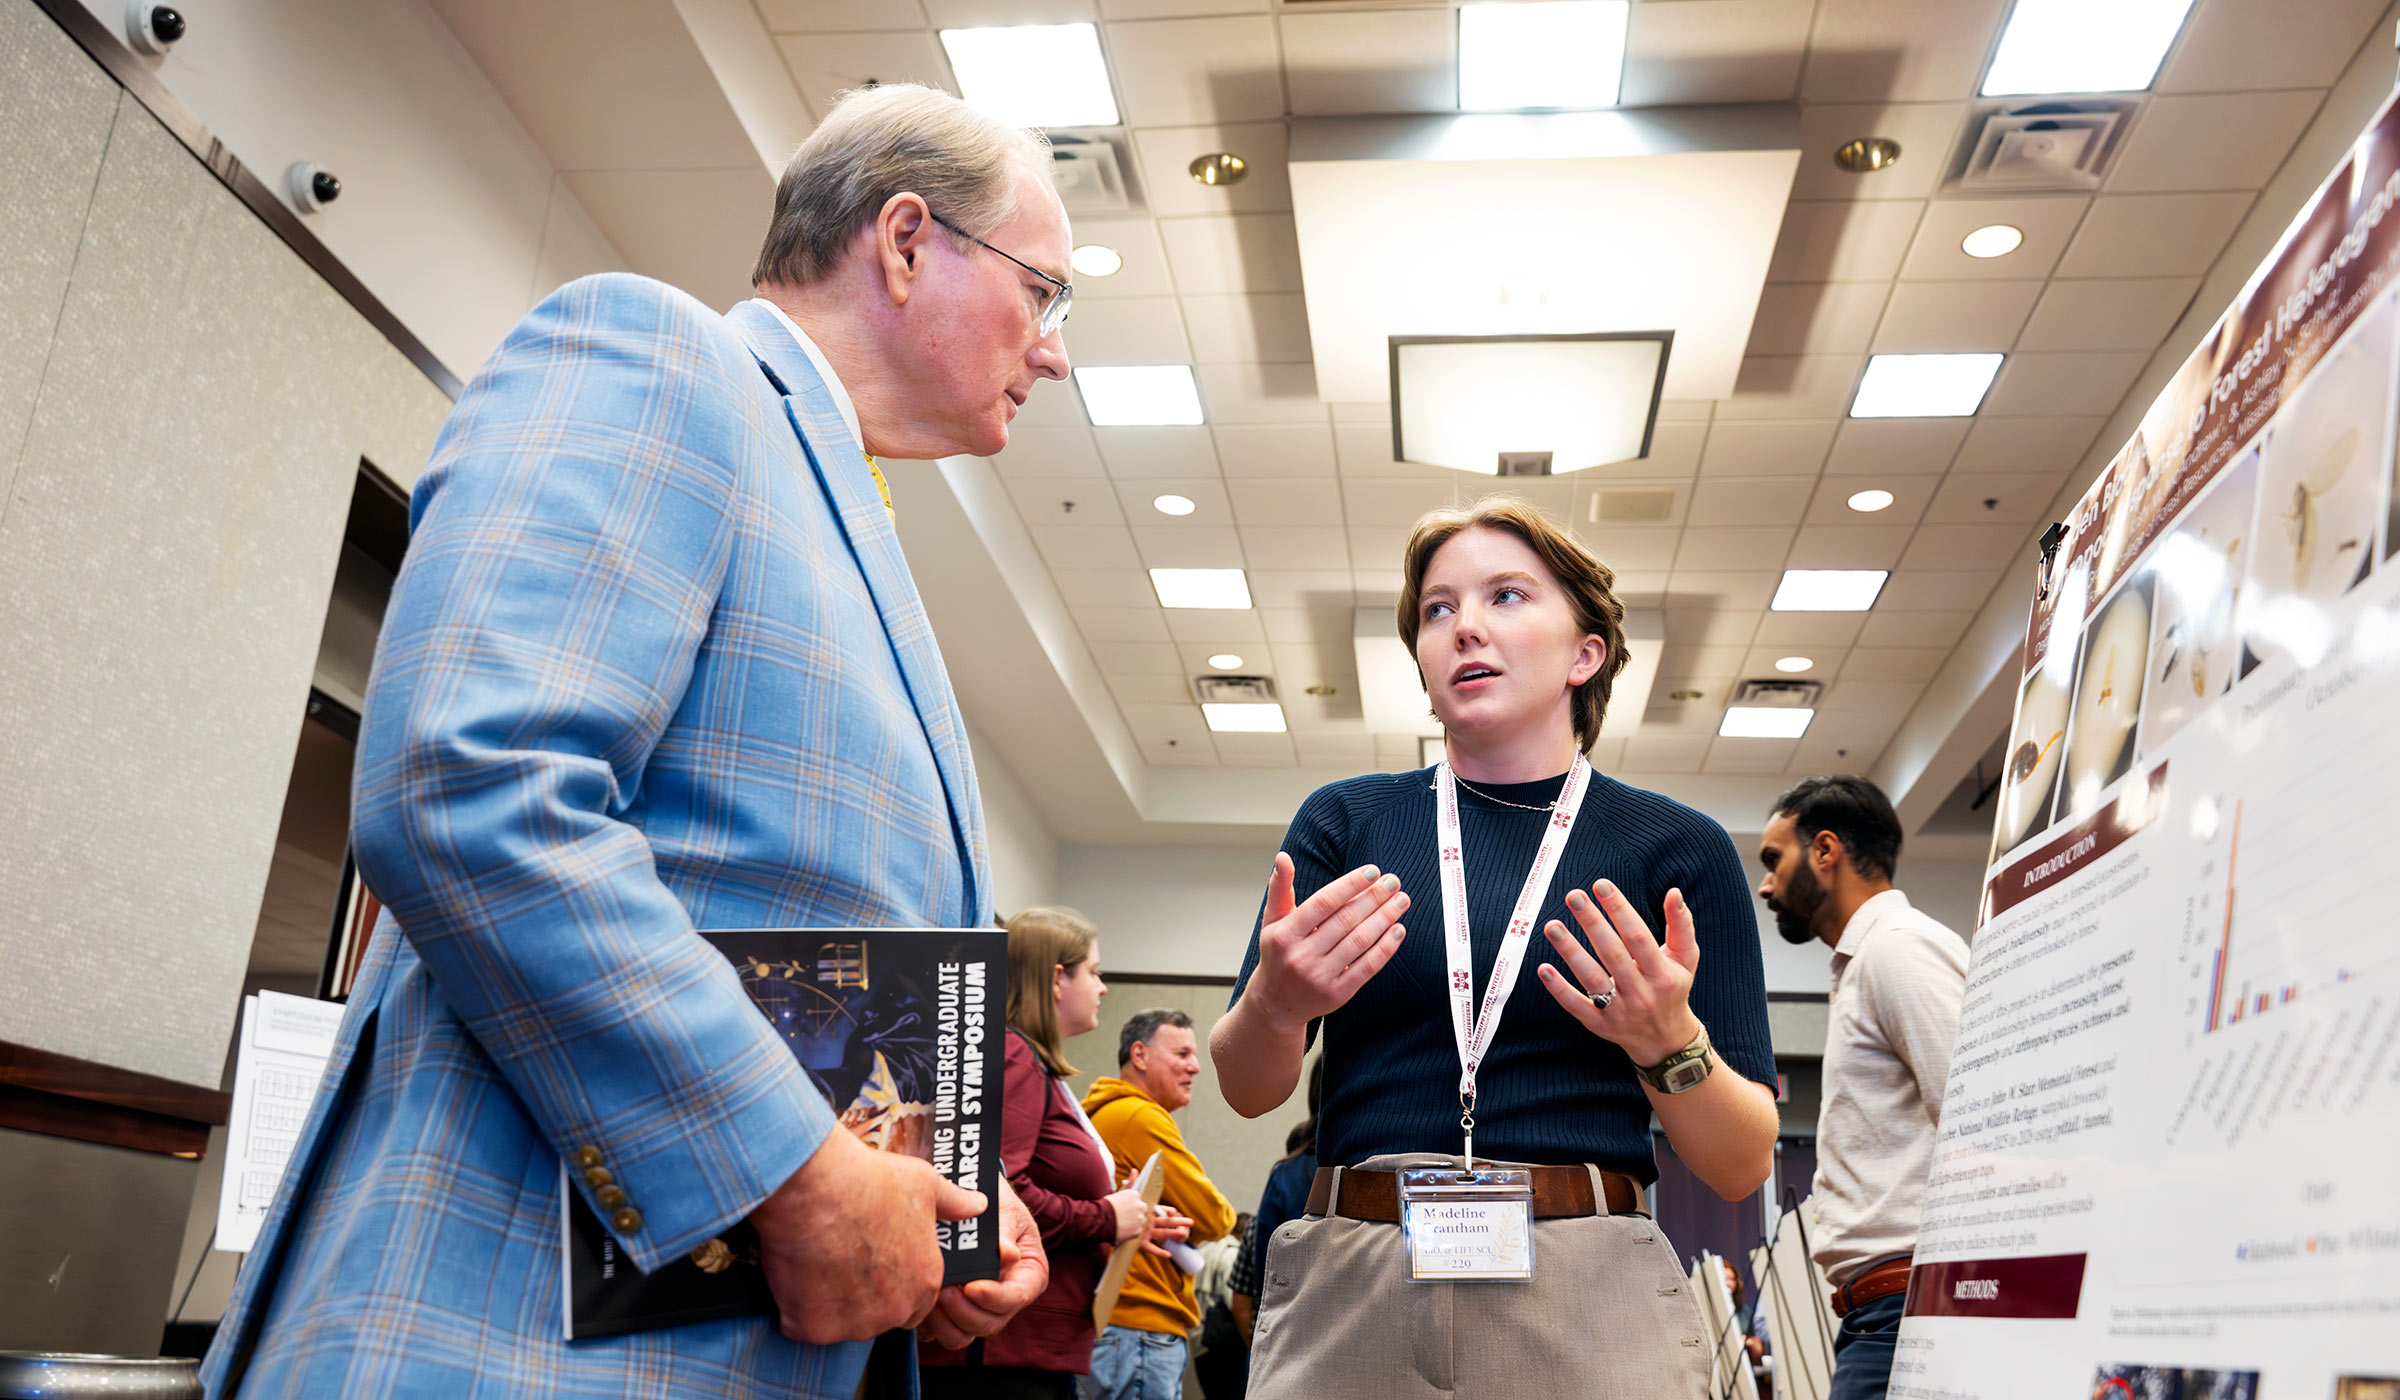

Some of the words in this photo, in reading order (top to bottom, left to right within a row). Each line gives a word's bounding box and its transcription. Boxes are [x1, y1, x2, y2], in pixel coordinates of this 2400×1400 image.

[2209, 320, 2272, 415] Forest
[2023, 831, 2097, 887] INTRODUCTION
[935, 962, 960, 1122] UNDERGRADUATE
[961, 961, 986, 1115] SYMPOSIUM
[1472, 1016, 1486, 1051] MISSISSIPPI
[1484, 995, 1493, 1015] STATE
[934, 1128, 954, 1180] RING
[958, 1122, 981, 1250] REARCH
[1424, 1207, 1486, 1218] Madeline
[1953, 1279, 1999, 1300] METHODS
